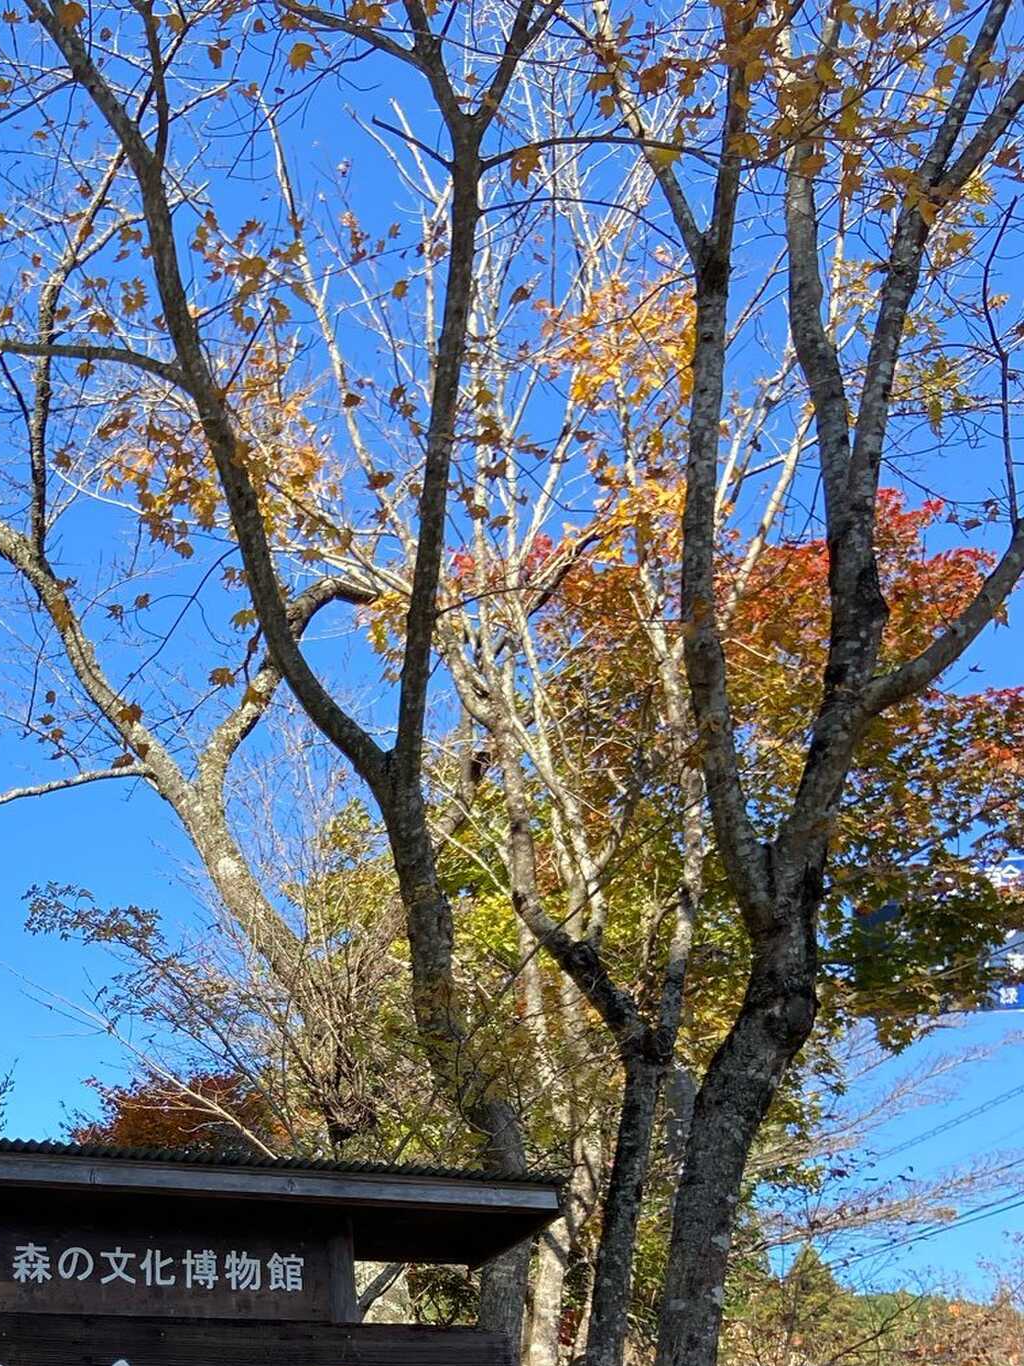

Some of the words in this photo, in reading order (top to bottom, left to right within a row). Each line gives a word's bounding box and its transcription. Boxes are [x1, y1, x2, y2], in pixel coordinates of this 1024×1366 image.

[12, 1242, 305, 1292] 森の文化博物館
